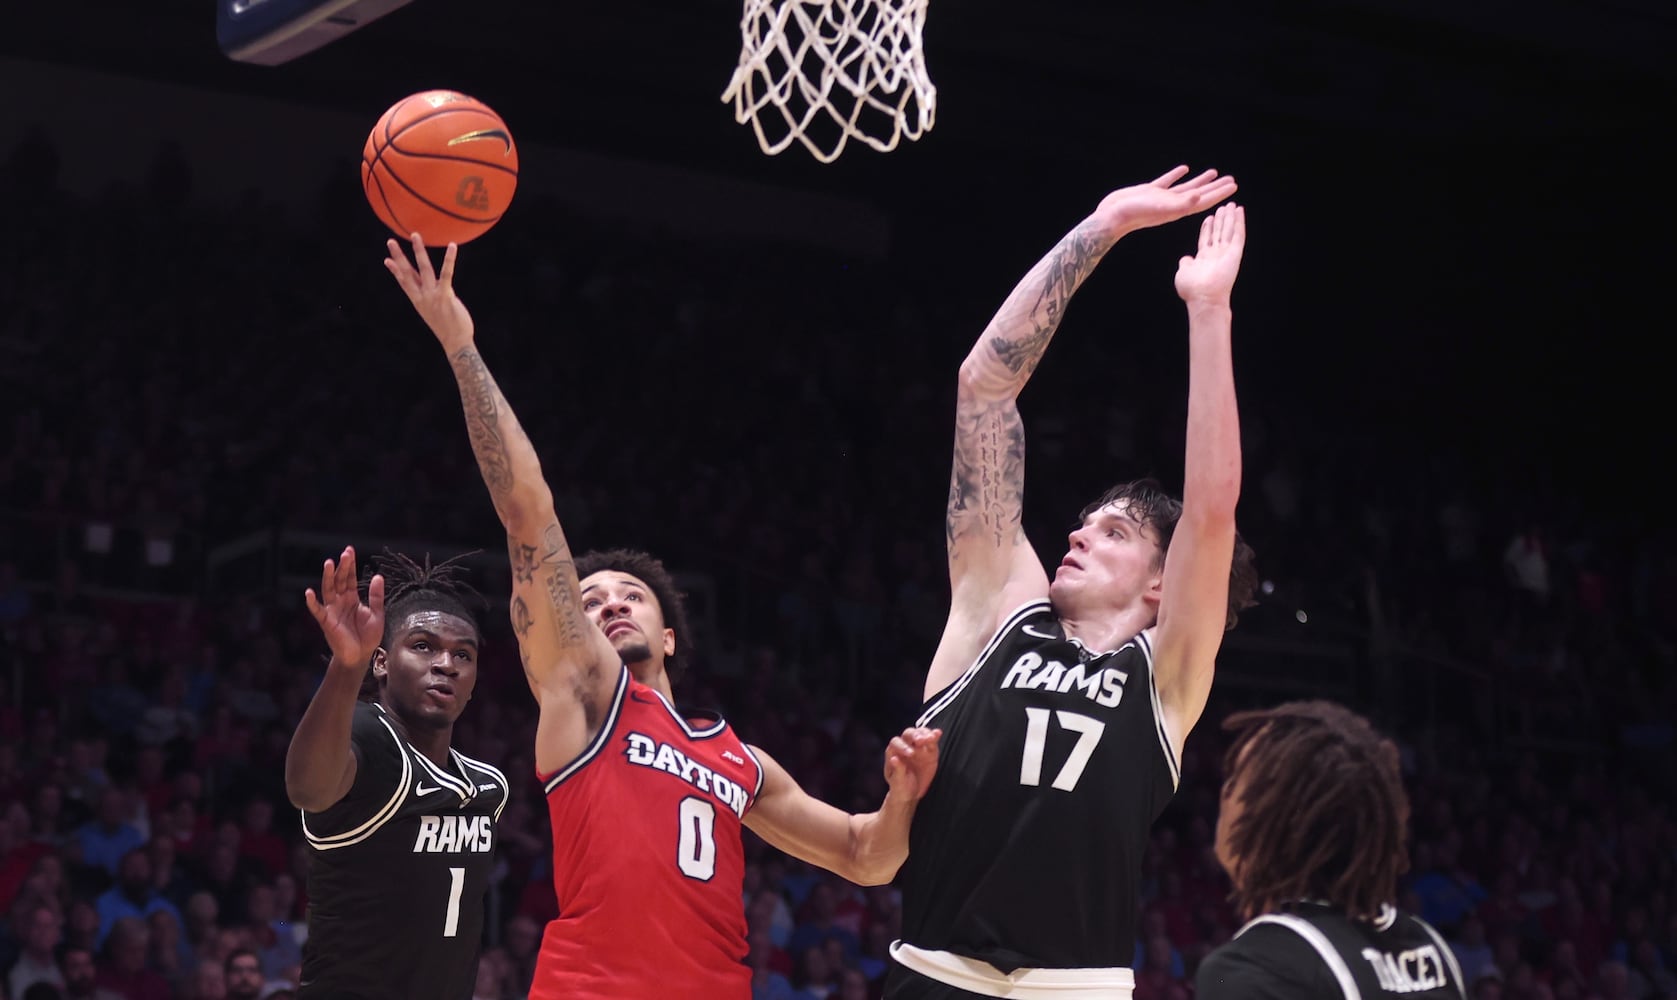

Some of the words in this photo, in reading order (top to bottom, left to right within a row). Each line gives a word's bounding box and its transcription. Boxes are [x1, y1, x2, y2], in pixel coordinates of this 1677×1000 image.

[1000, 652, 1128, 708] RAMS
[625, 732, 748, 820] DAYTON
[1020, 707, 1105, 792] 17
[413, 816, 492, 852] RAMS
[677, 796, 715, 881] 0
[443, 867, 465, 937] 1
